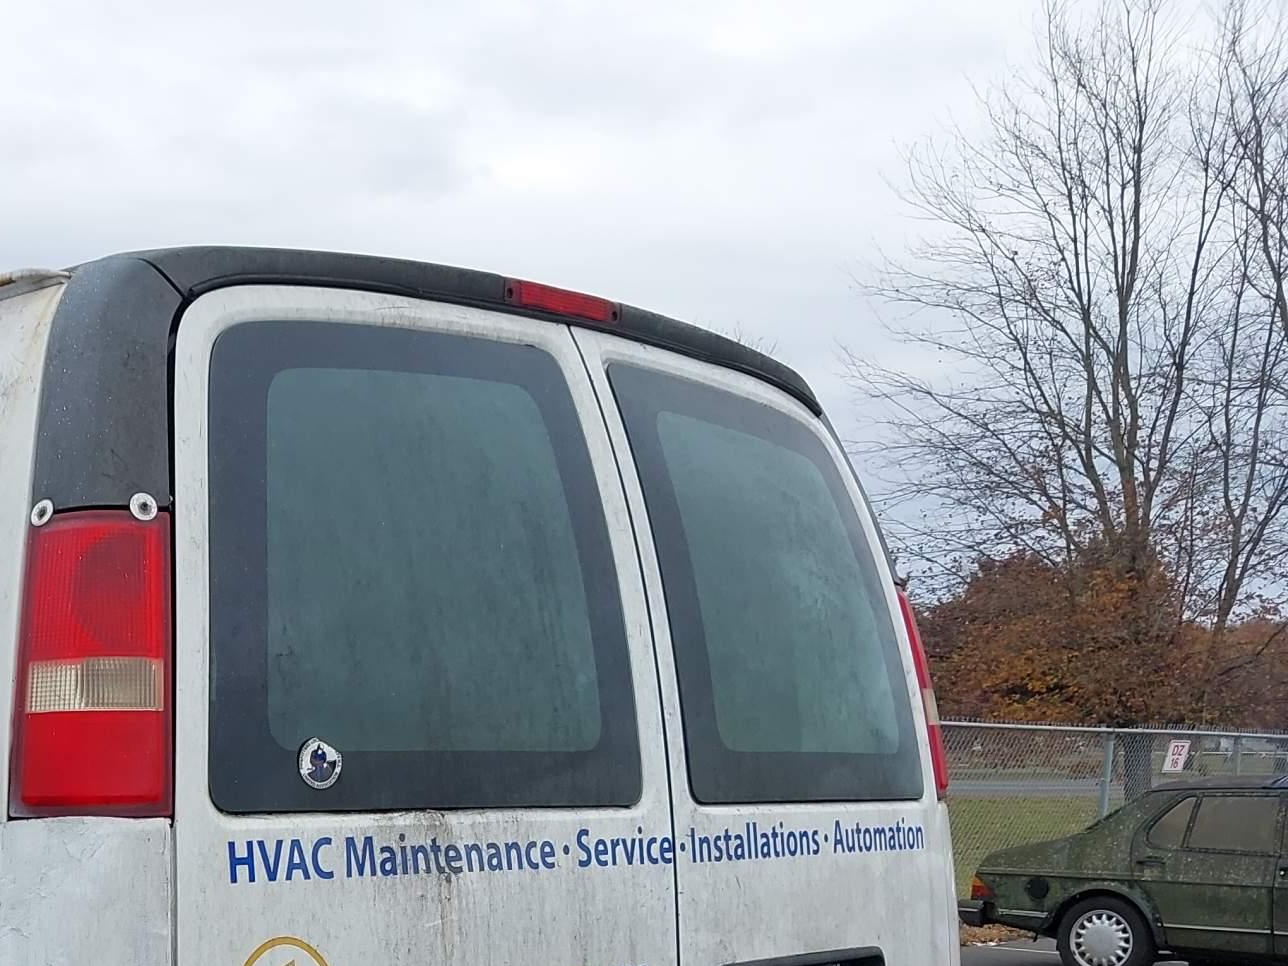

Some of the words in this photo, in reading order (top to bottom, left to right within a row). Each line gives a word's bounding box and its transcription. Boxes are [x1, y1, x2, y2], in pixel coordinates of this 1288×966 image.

[228, 837, 334, 884] HVAC
[345, 833, 557, 880] Maintenance
[577, 826, 673, 867] Service
[690, 820, 820, 864] Installations
[833, 816, 925, 854] Automation
